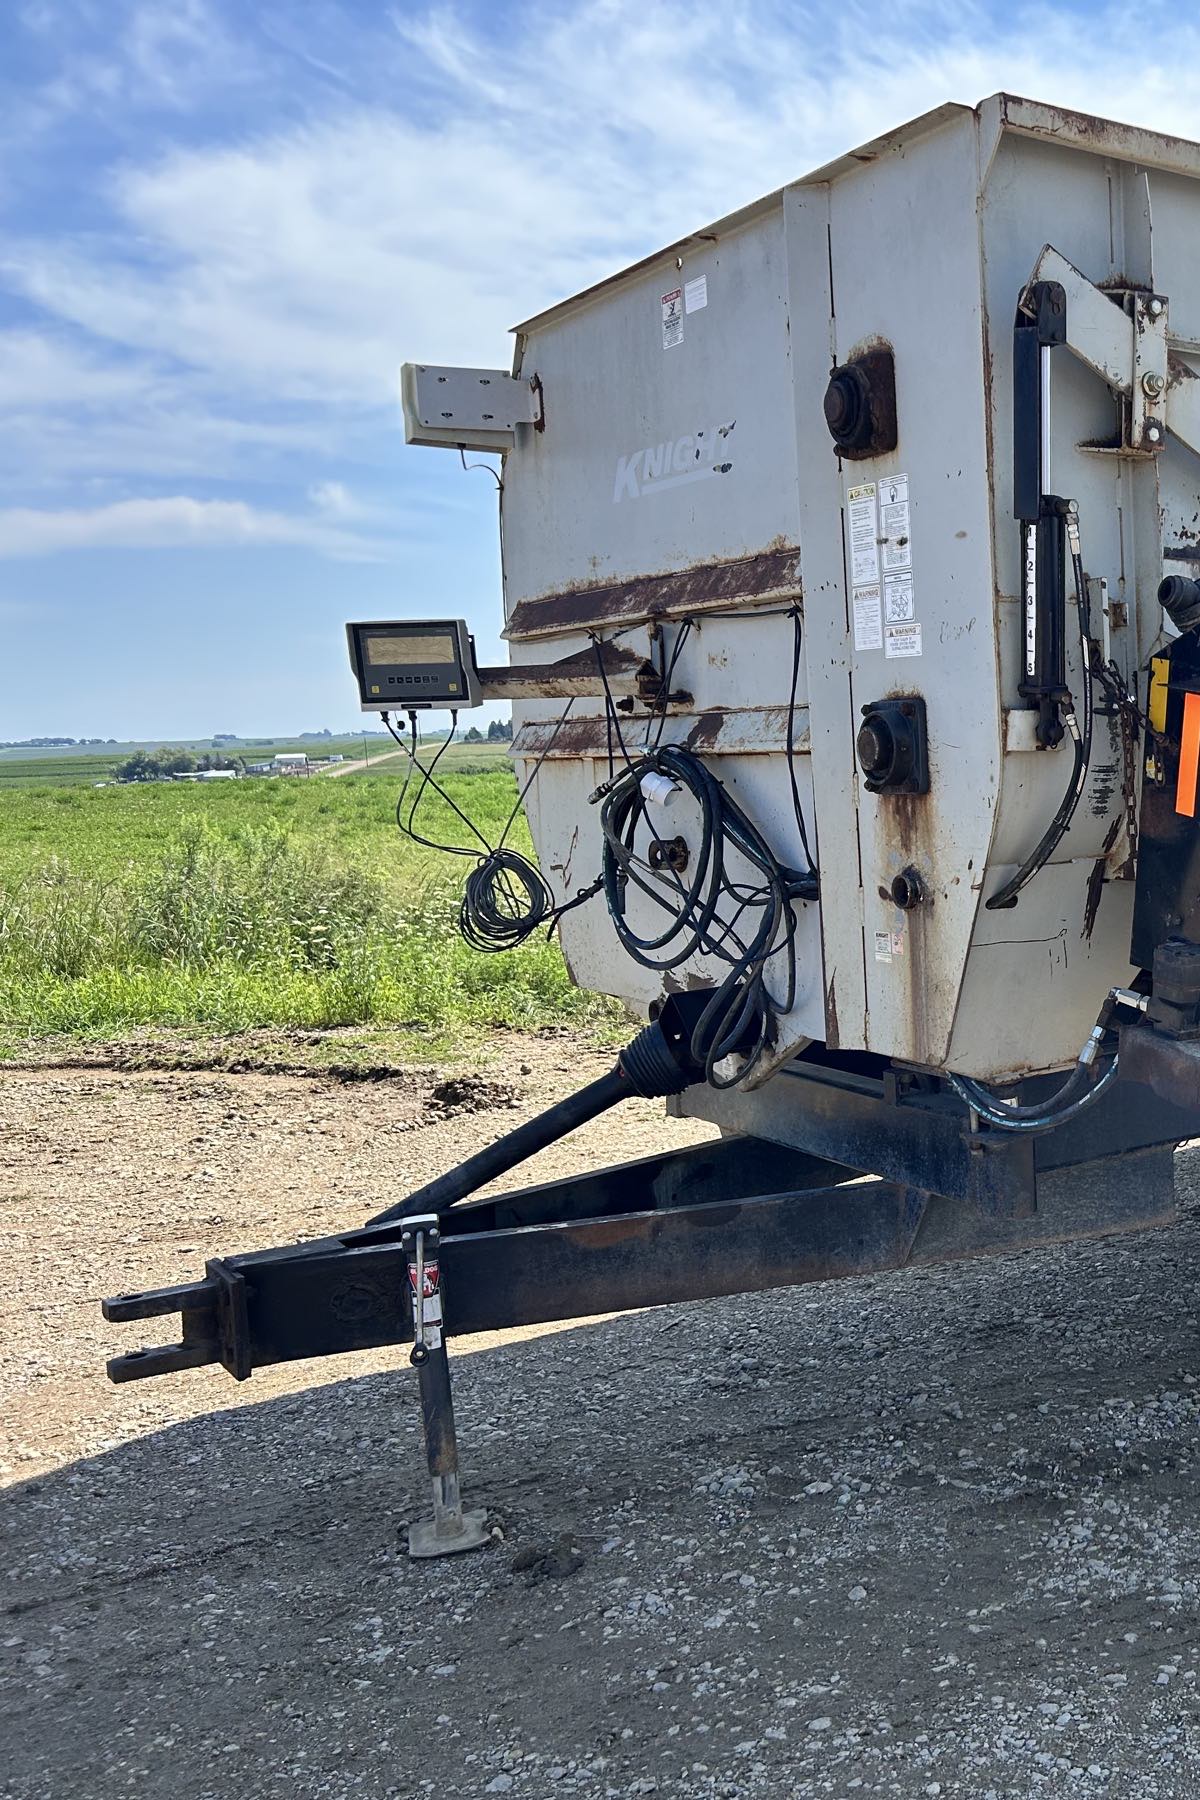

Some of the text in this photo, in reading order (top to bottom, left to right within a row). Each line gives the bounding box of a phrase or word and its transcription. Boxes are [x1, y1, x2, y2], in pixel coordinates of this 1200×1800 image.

[1027, 561, 1034, 571] 2
[1027, 595, 1033, 606] 3
[1027, 629, 1034, 640] 4
[1027, 662, 1033, 673] 5
[410, 1266, 438, 1274] BUDOG
